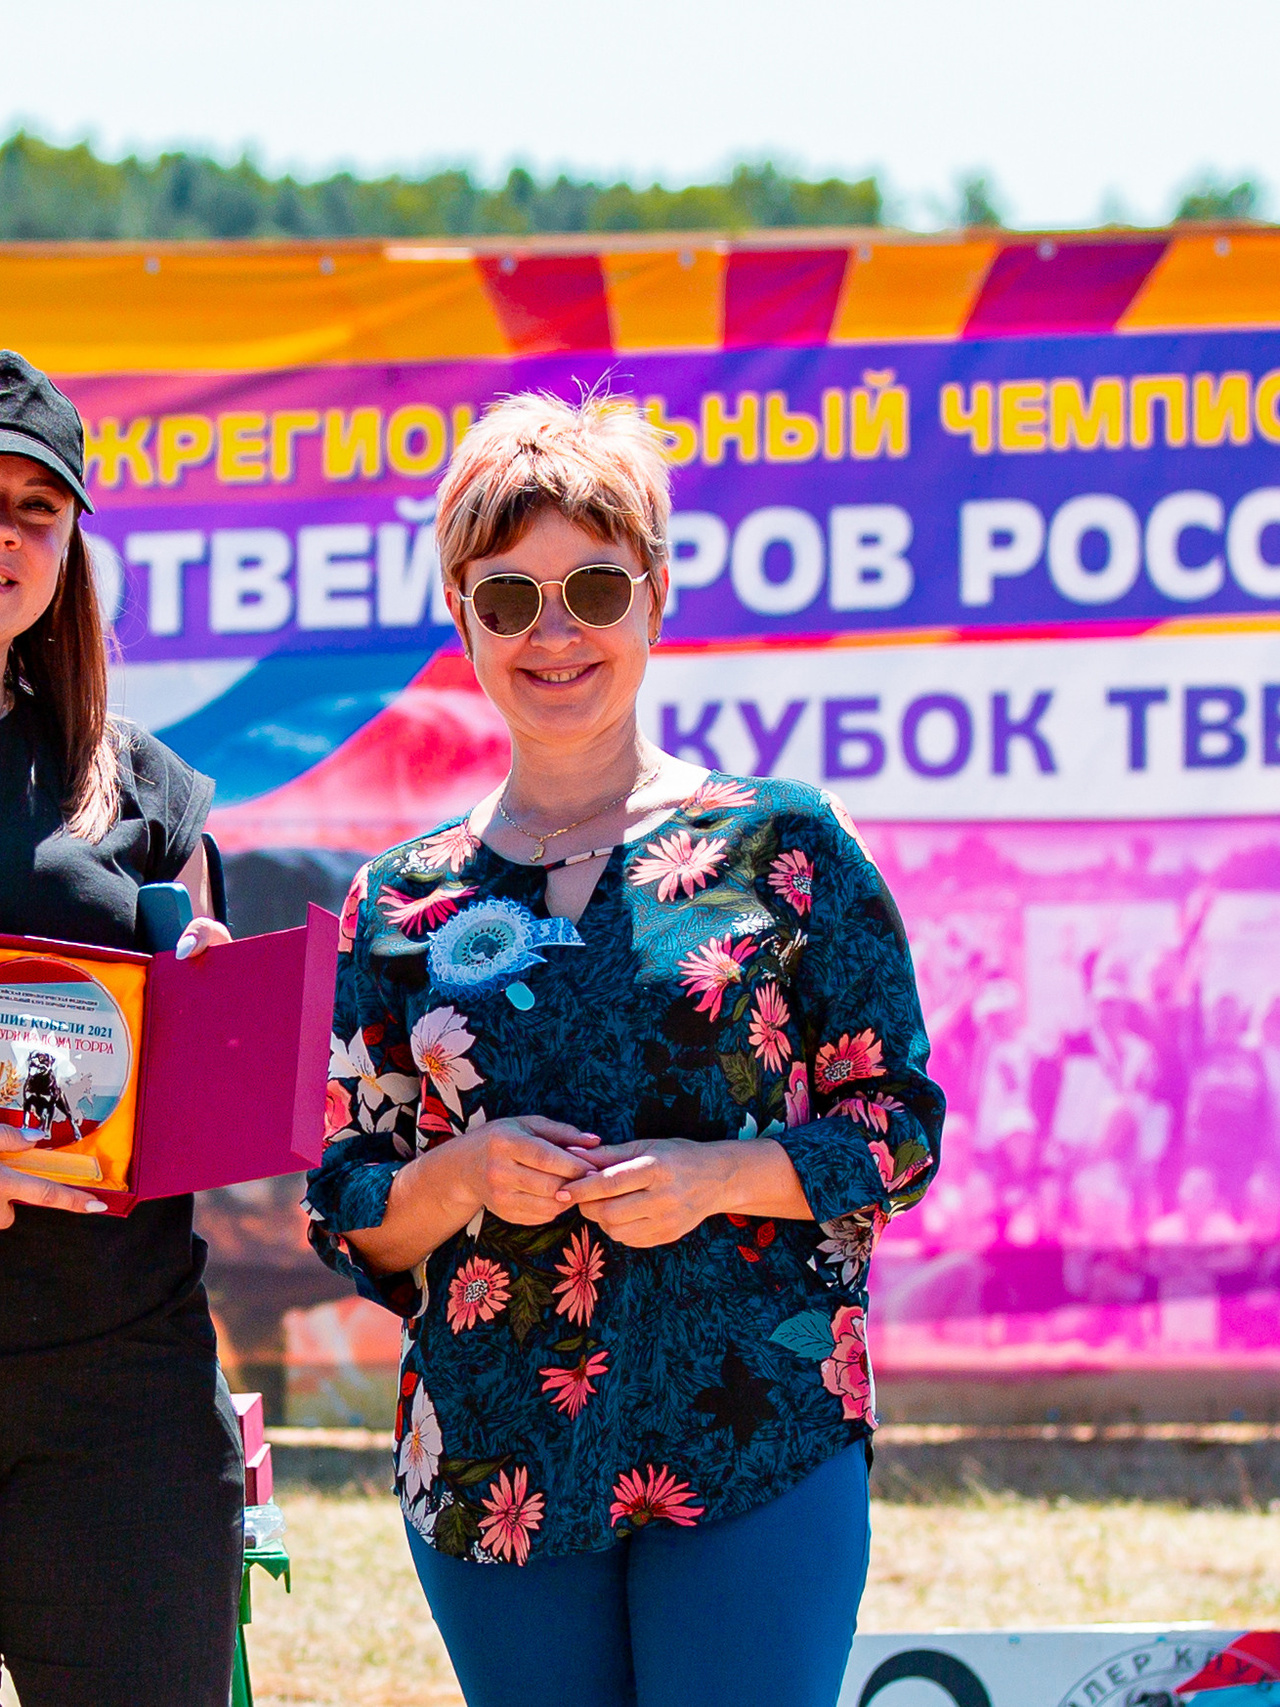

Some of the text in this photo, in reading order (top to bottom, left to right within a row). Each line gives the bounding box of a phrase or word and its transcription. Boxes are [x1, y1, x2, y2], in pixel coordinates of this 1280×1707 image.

[659, 688, 1059, 782] КУБОК
[31, 1016, 85, 1034] КОБЕЛИ
[88, 1025, 113, 1039] 2021
[74, 1038, 114, 1054] ТОРРА
